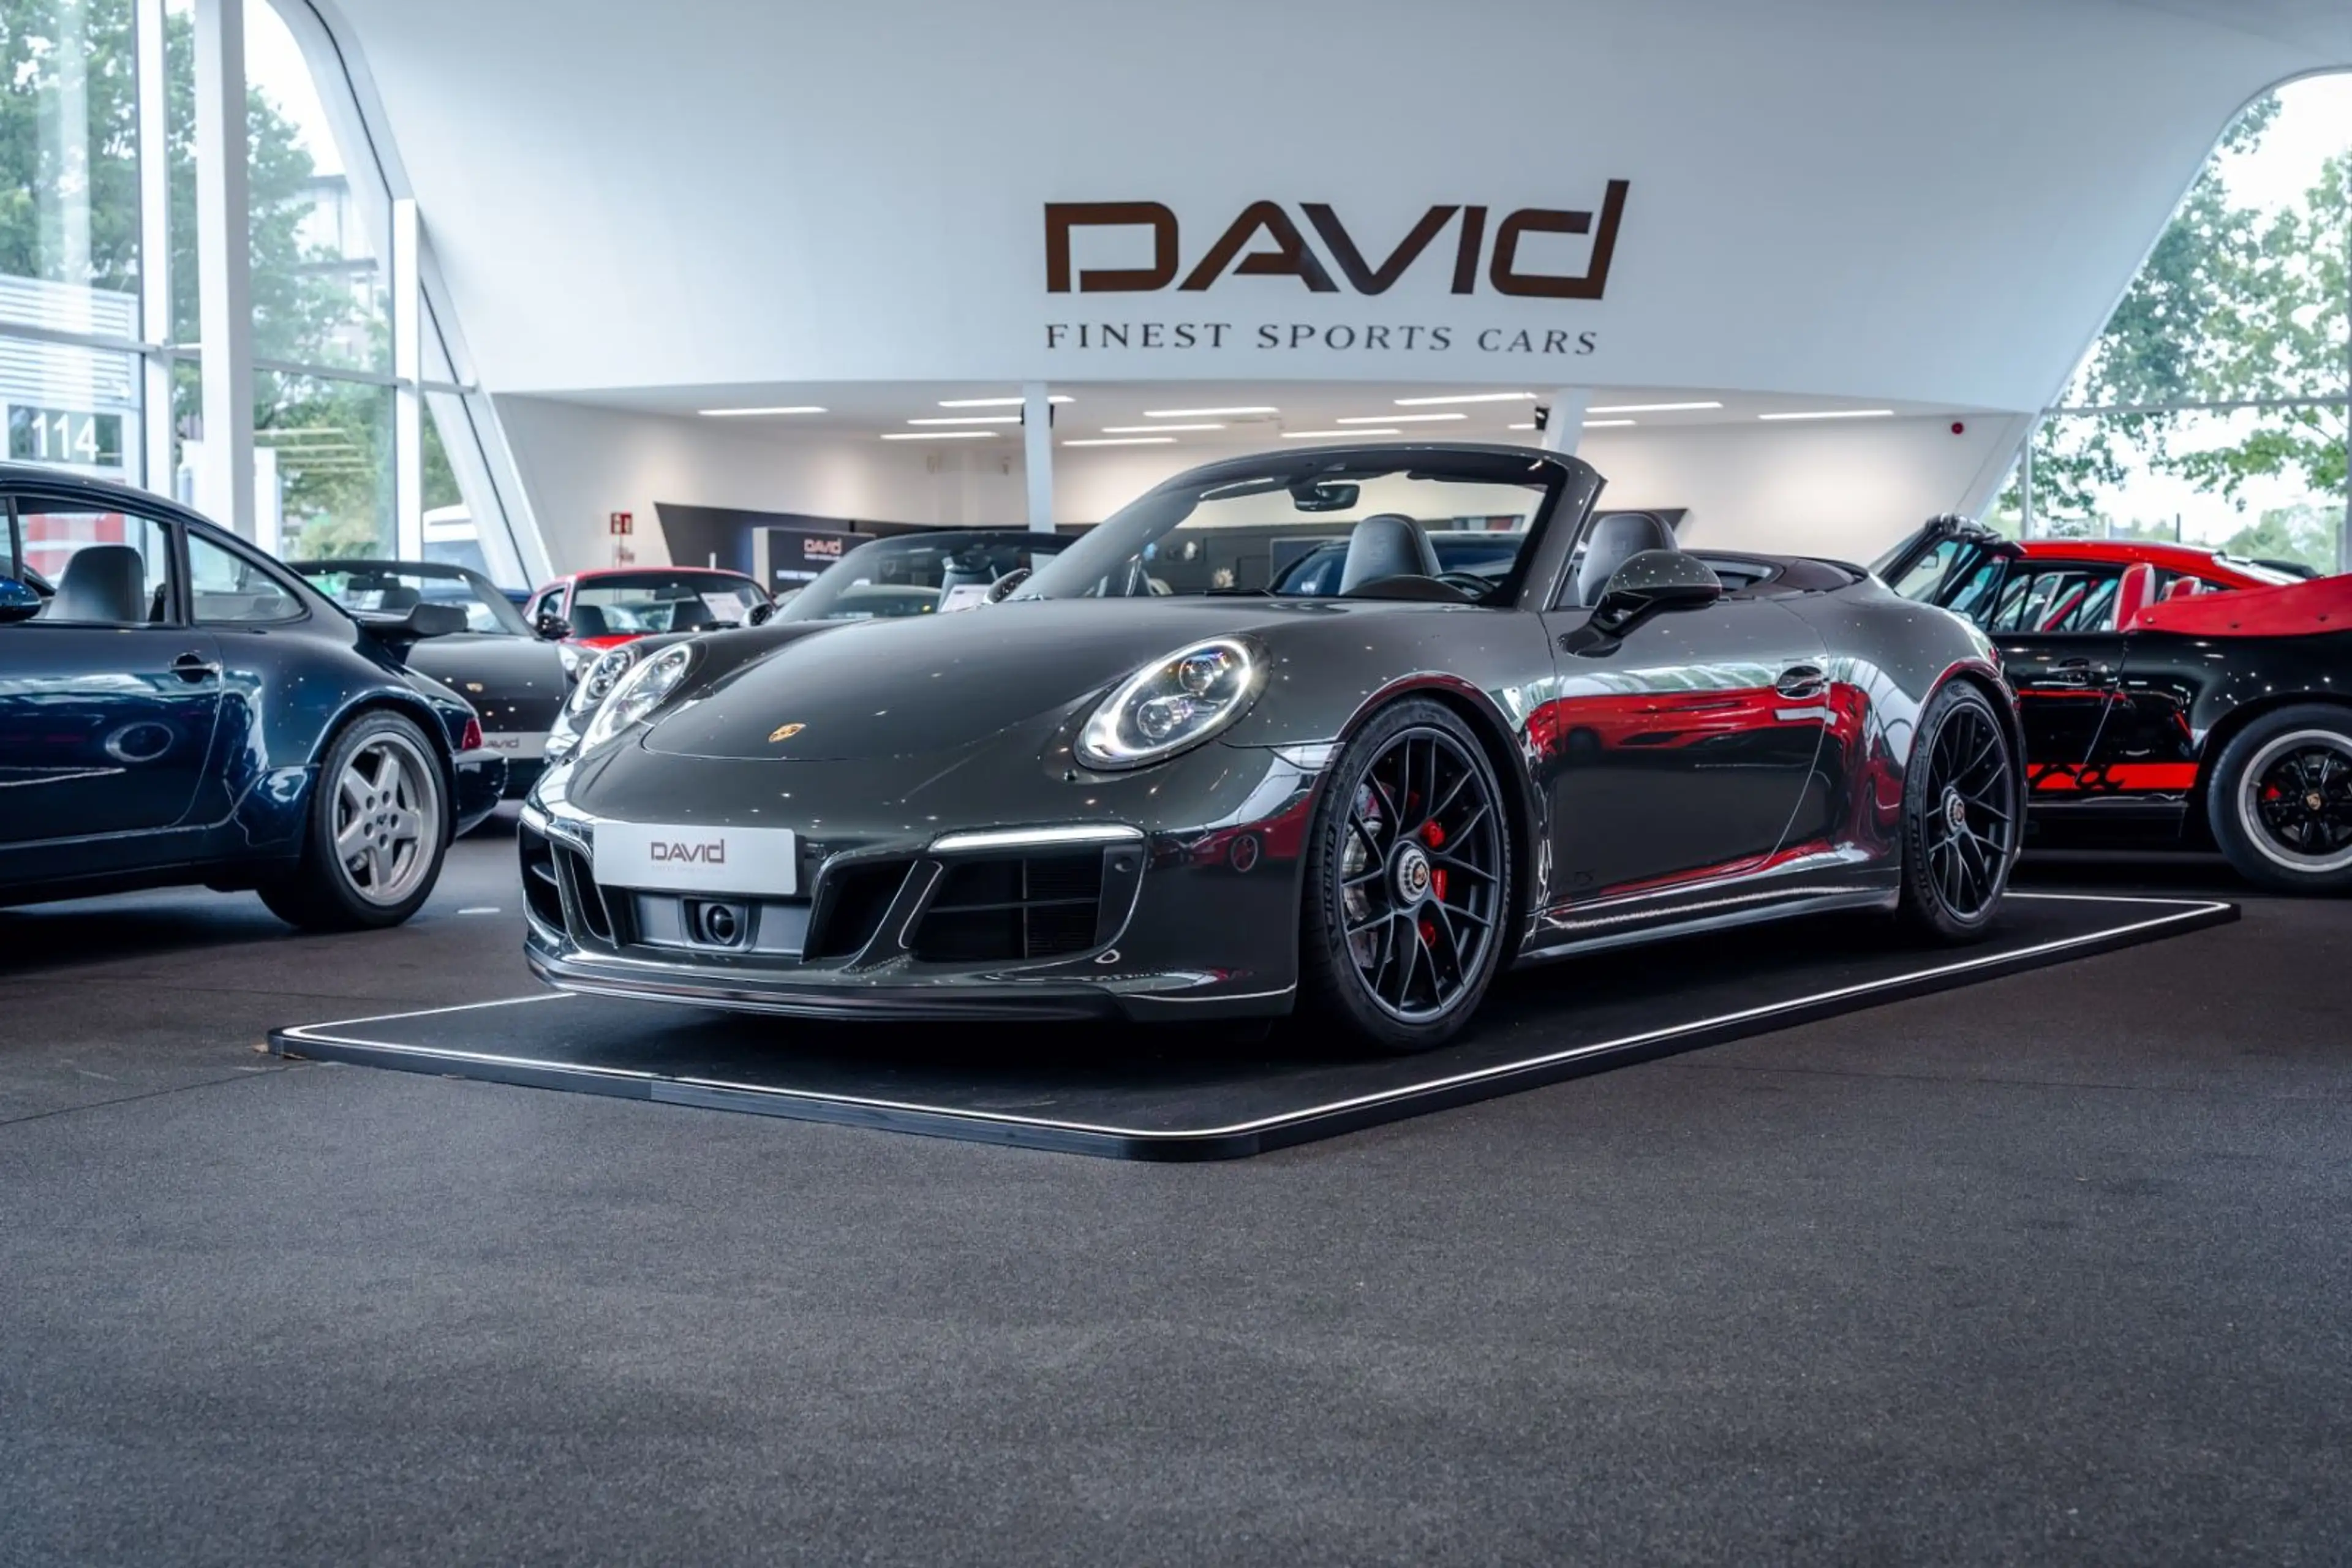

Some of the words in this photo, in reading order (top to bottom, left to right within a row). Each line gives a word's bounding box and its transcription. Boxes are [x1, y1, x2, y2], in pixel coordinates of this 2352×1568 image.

[1046, 323, 1231, 349] FINEST
[1257, 324, 1451, 350] SPORTS
[1477, 329, 1597, 355] CARS
[31, 411, 100, 461] 114
